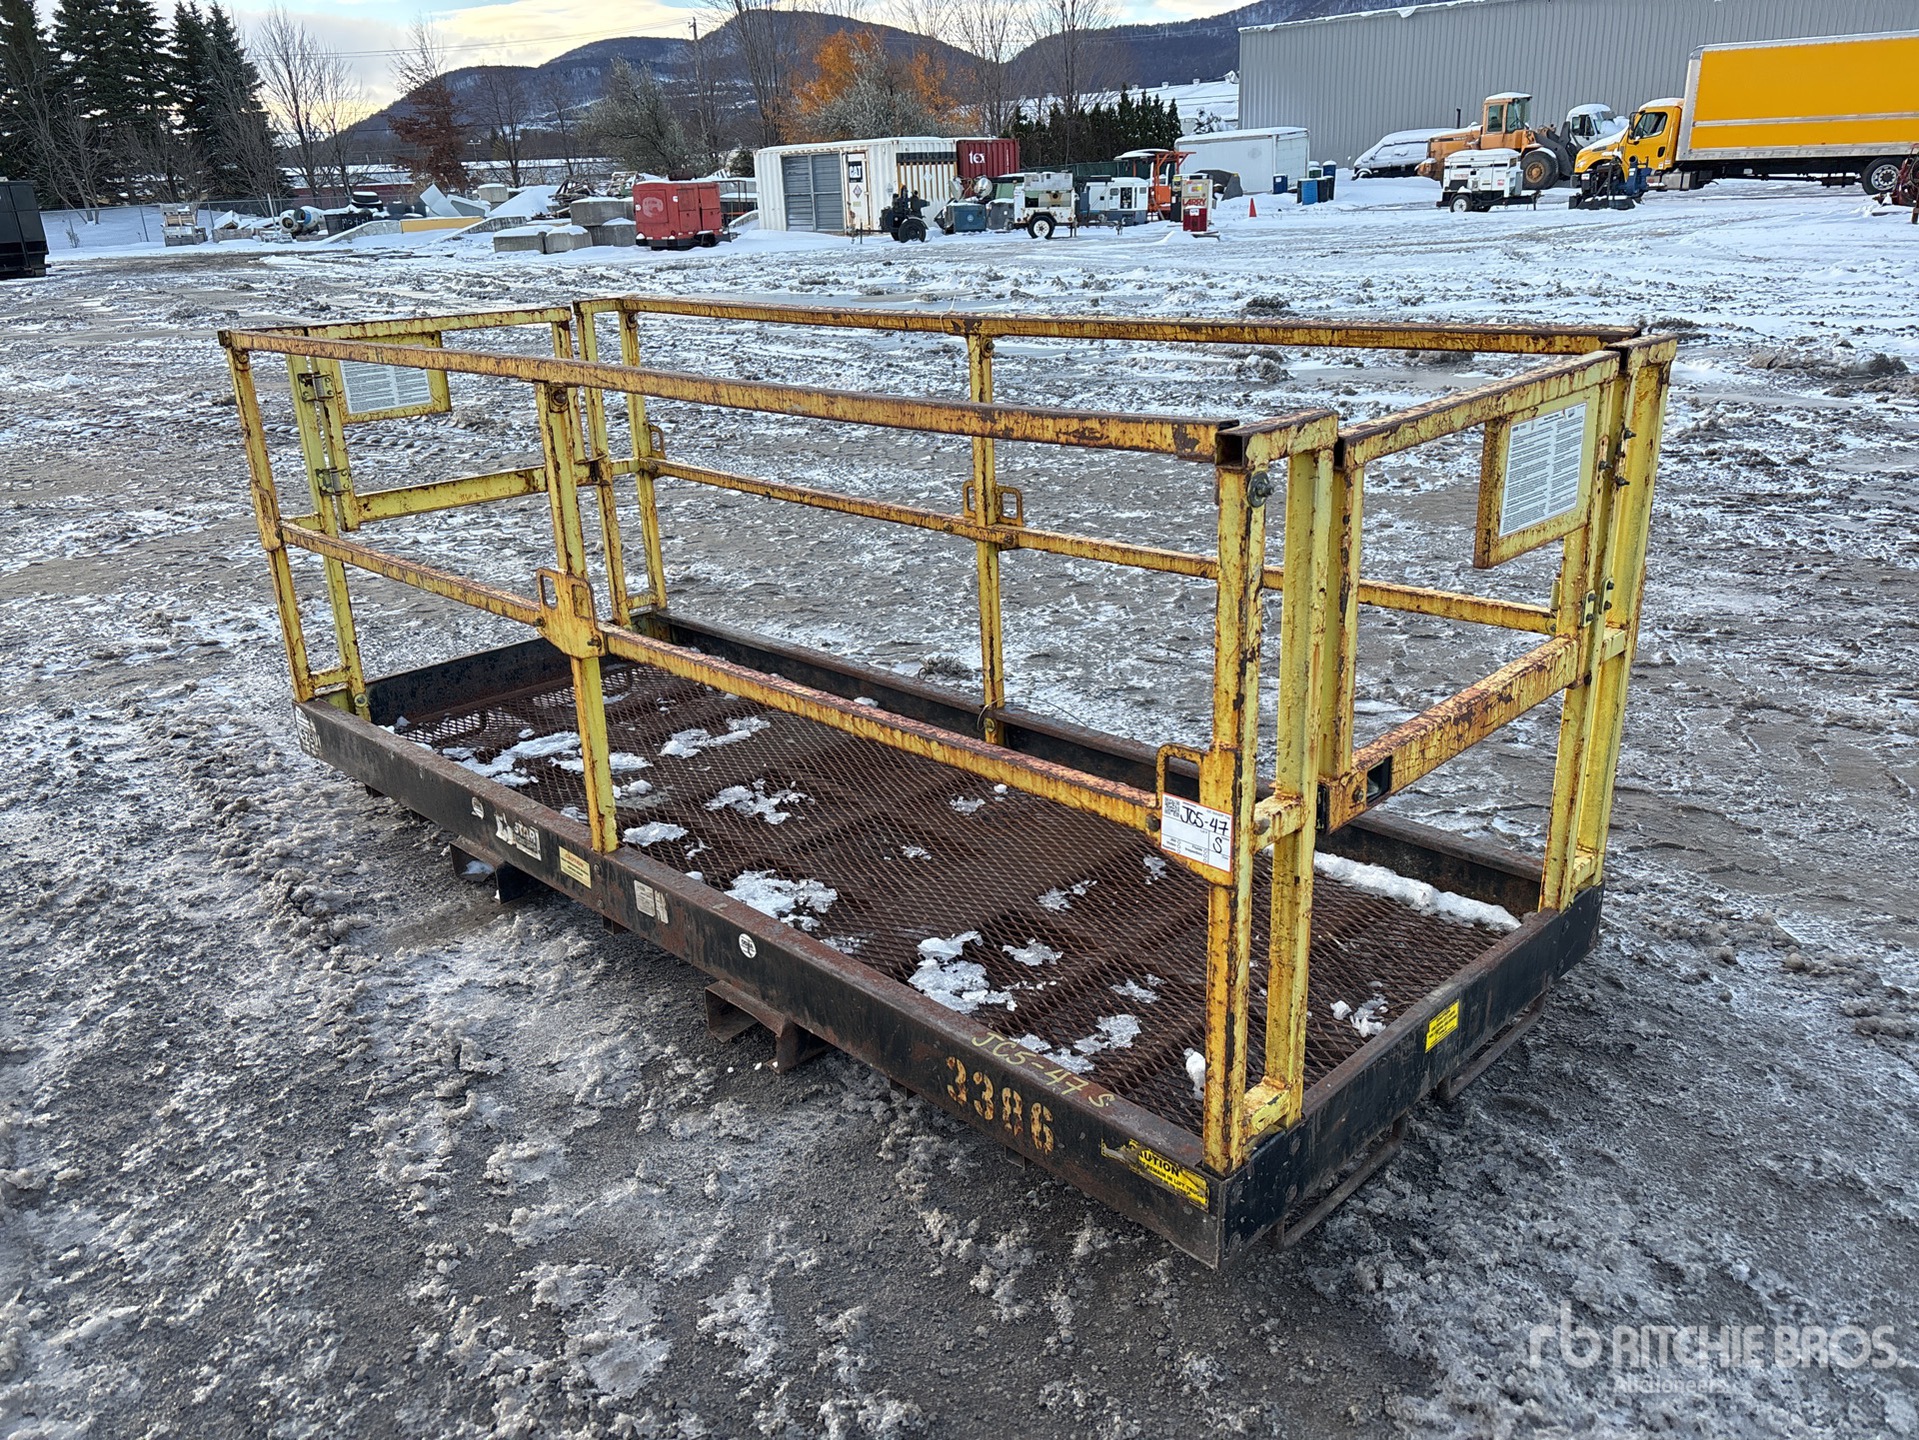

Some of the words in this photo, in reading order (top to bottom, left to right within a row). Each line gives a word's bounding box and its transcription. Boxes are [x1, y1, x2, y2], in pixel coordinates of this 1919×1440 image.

[849, 165, 862, 178] CAT
[1212, 836, 1223, 854] S
[945, 1056, 1054, 1156] 3386
